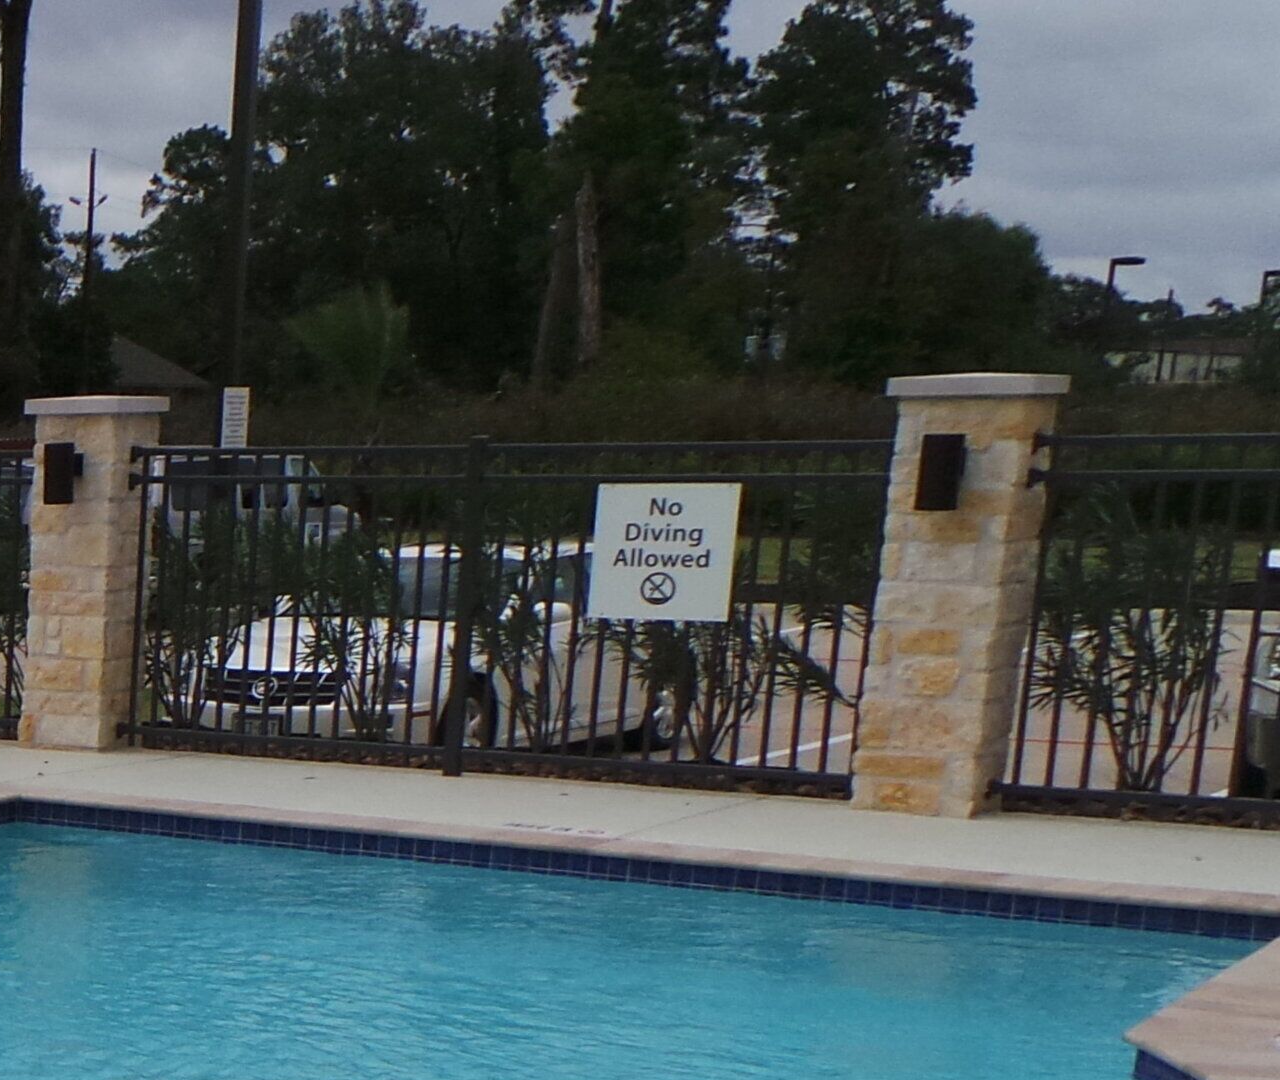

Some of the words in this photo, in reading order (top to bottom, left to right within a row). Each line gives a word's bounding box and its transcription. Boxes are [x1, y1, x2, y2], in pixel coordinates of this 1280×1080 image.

[649, 497, 683, 516] No
[625, 522, 703, 546] Diving
[613, 548, 711, 568] Allowed
